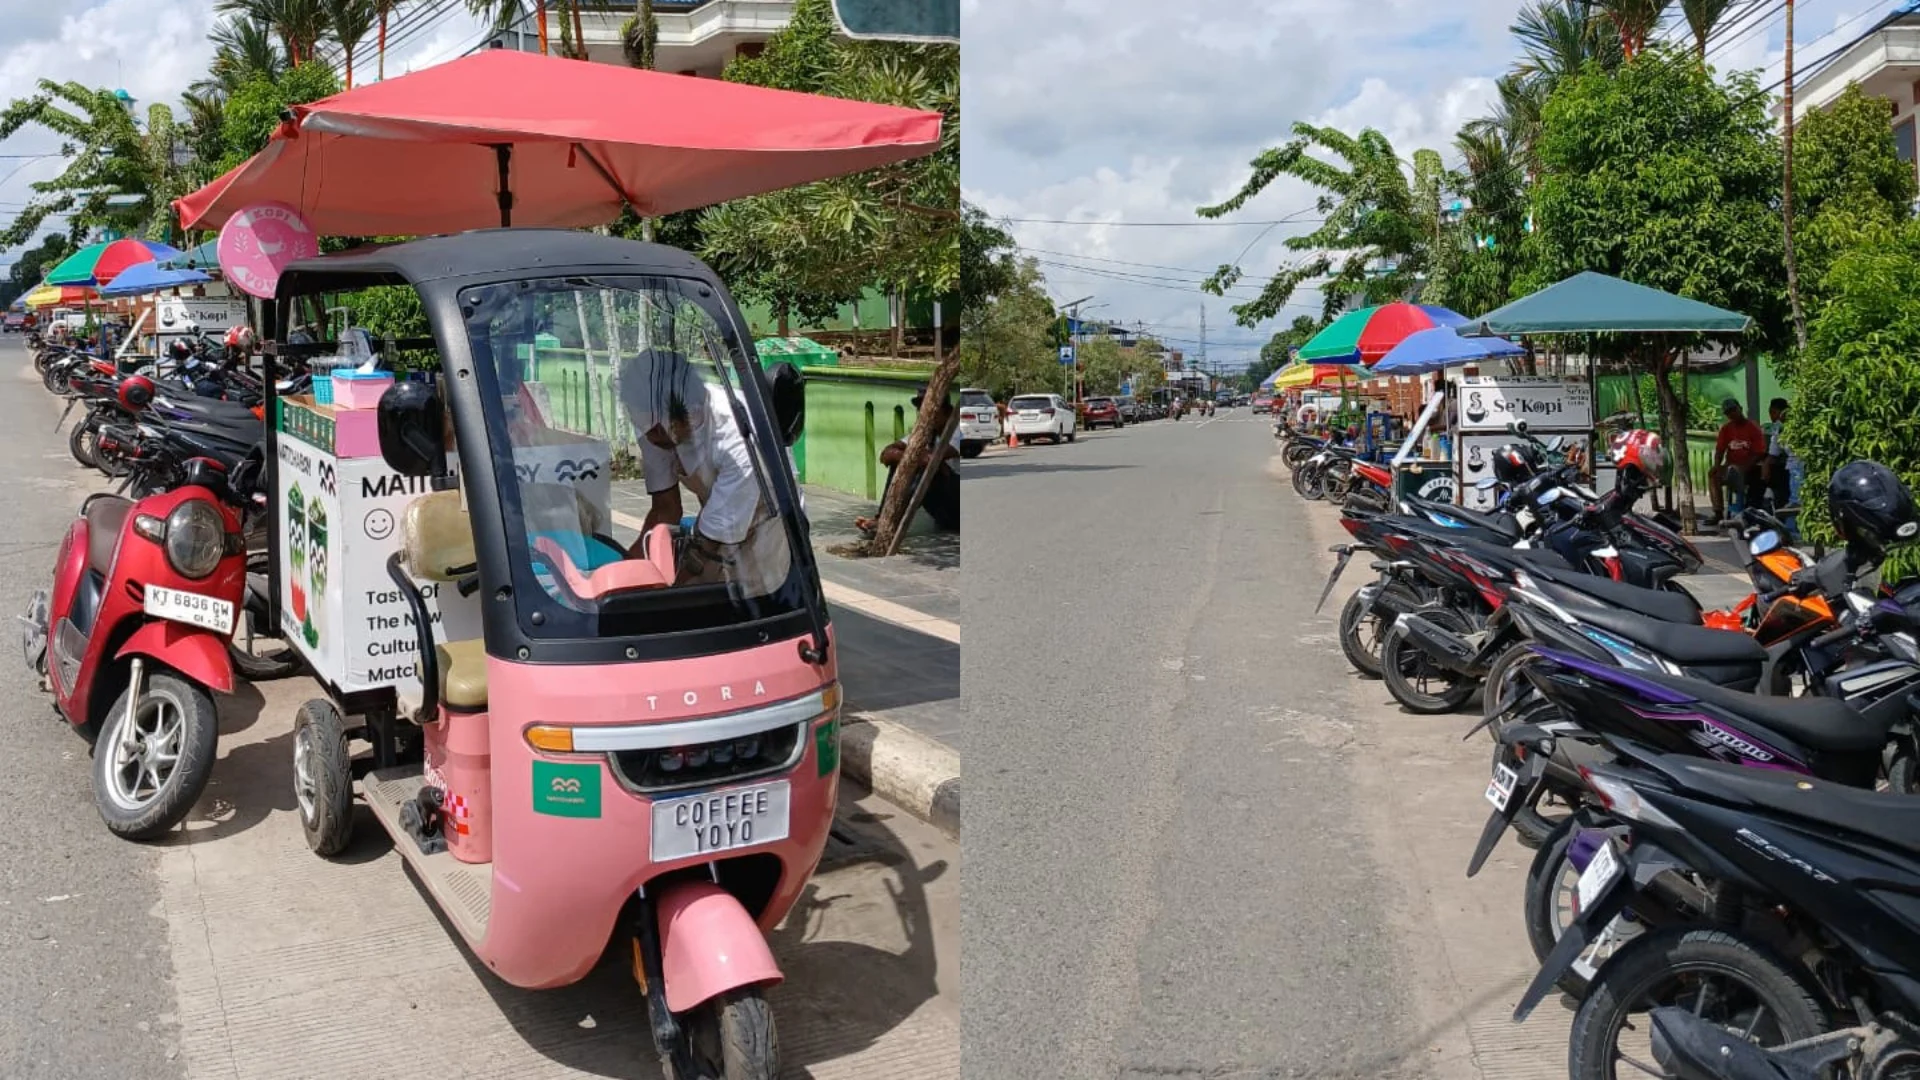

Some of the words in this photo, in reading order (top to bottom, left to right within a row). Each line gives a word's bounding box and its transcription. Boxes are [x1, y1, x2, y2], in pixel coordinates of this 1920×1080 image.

[245, 271, 277, 292] YOY
[180, 310, 228, 322] Se'Kopi
[1493, 397, 1563, 415] Se'Kopi
[174, 594, 209, 611] 6836
[366, 591, 405, 605] Tast
[366, 616, 399, 631] The
[404, 611, 442, 627] Nw
[367, 639, 420, 656] Cultu
[368, 662, 418, 682] Matc
[646, 680, 766, 711] TORA
[676, 791, 768, 826] COFFEE
[695, 820, 752, 851] YOYO
